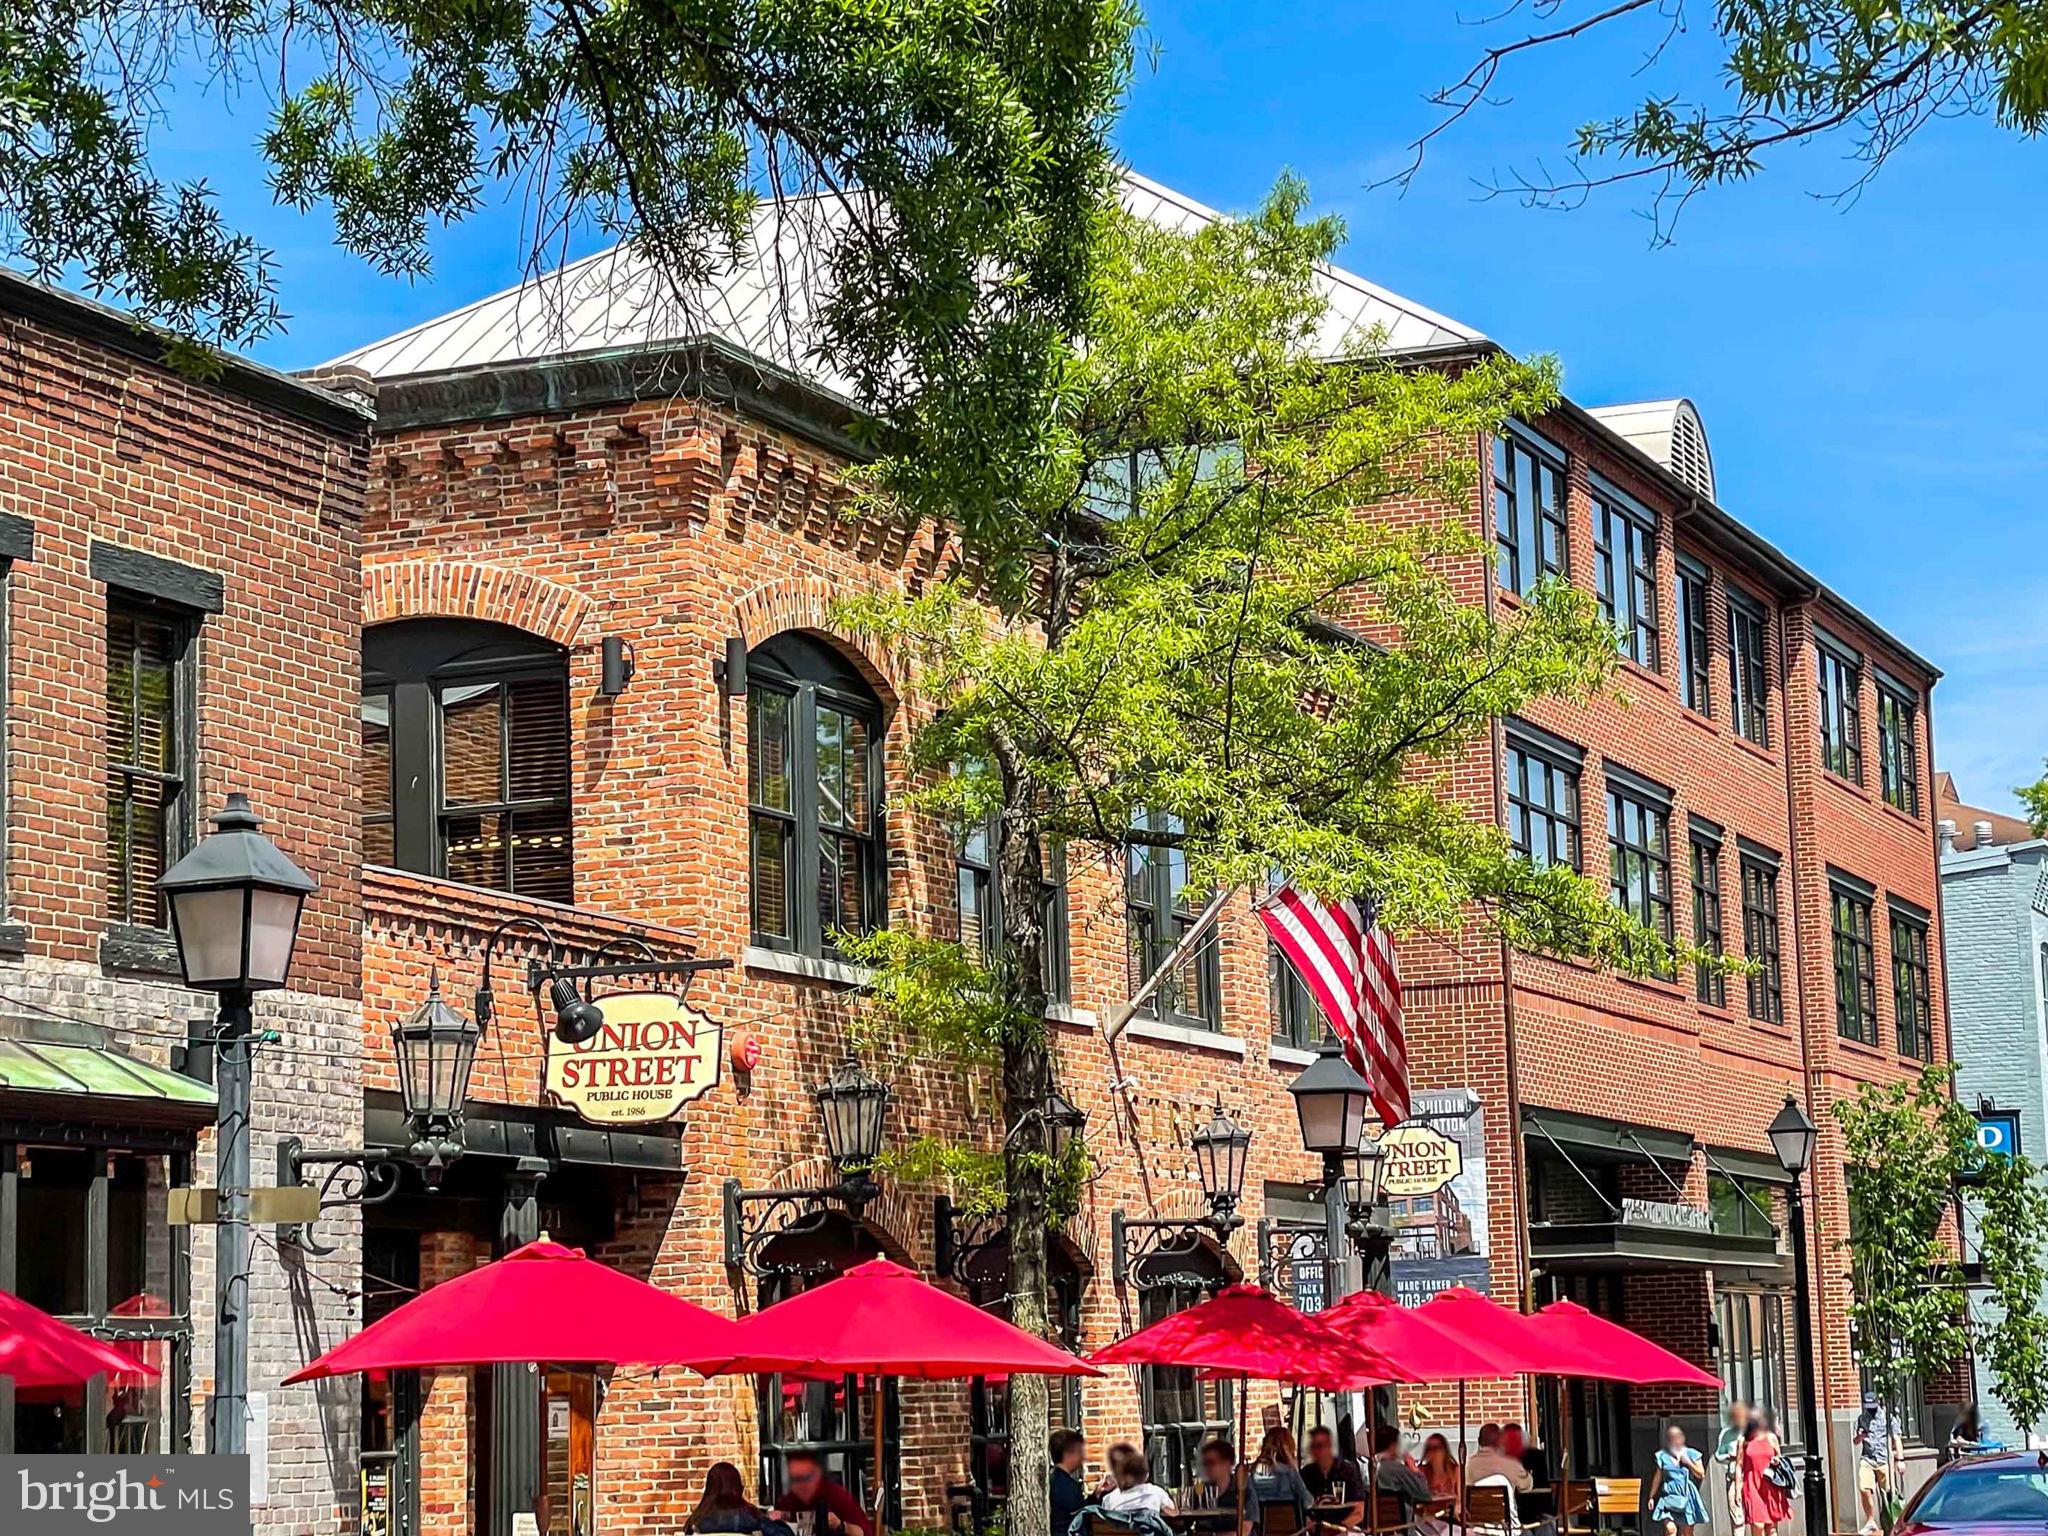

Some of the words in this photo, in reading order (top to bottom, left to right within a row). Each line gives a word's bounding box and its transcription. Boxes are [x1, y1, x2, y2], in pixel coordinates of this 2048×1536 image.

[562, 1055, 702, 1089] STREET
[586, 1091, 631, 1102] PUBLIC
[632, 1089, 673, 1100] HOUSE
[611, 1109, 625, 1117] est.
[627, 1107, 646, 1116] 1986
[1383, 1159, 1452, 1177] TREET
[1299, 1266, 1324, 1280] OFFIC
[1298, 1284, 1317, 1295] JACK
[1397, 1281, 1420, 1292] MARC
